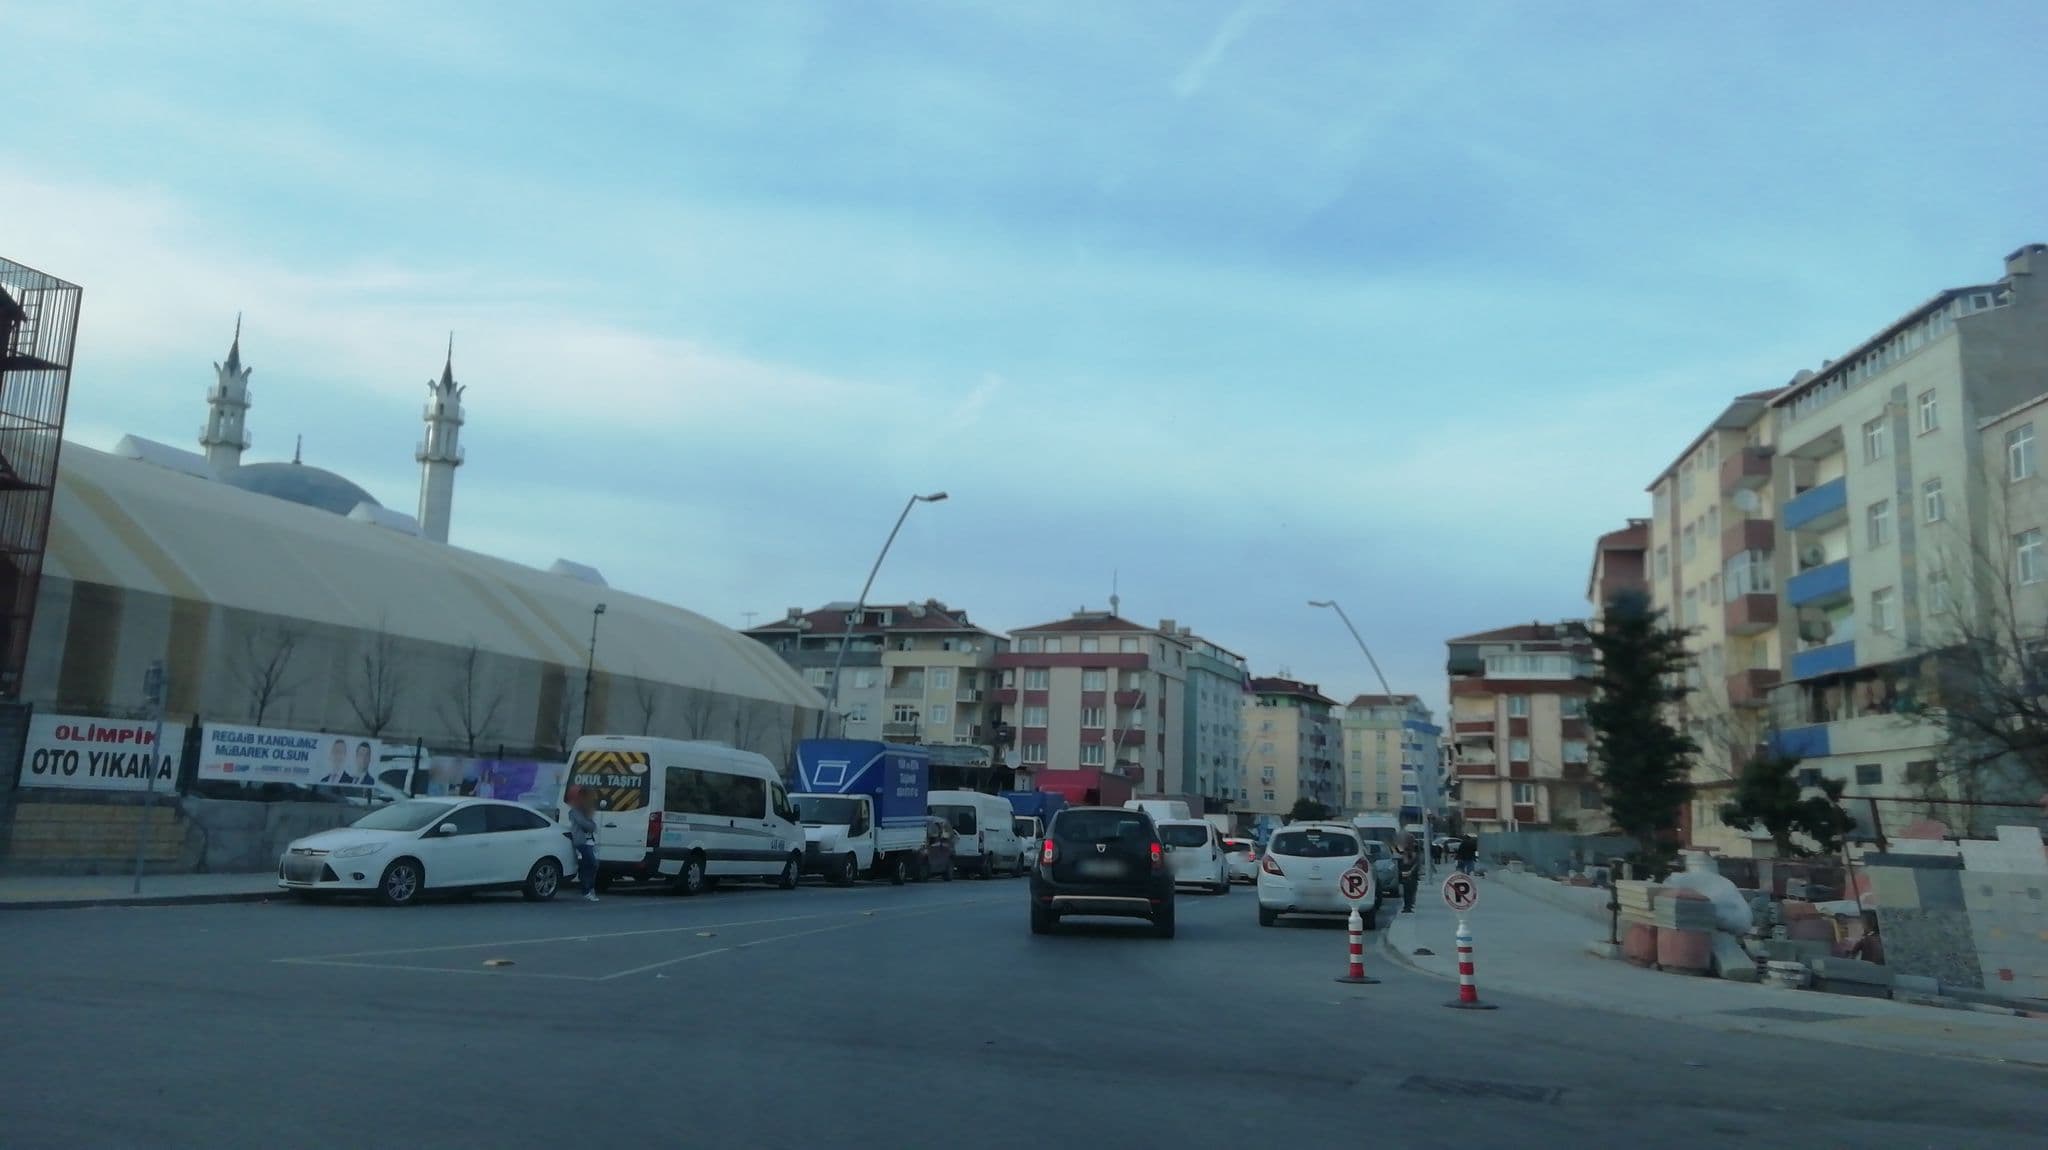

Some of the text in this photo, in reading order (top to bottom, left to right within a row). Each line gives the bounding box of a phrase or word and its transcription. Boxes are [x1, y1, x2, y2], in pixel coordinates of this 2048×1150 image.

[32, 748, 79, 776] OTO
[272, 748, 309, 762] OLSUN
[574, 773, 603, 787] OKUL
[1349, 875, 1363, 893] P
[1453, 882, 1470, 903] P
